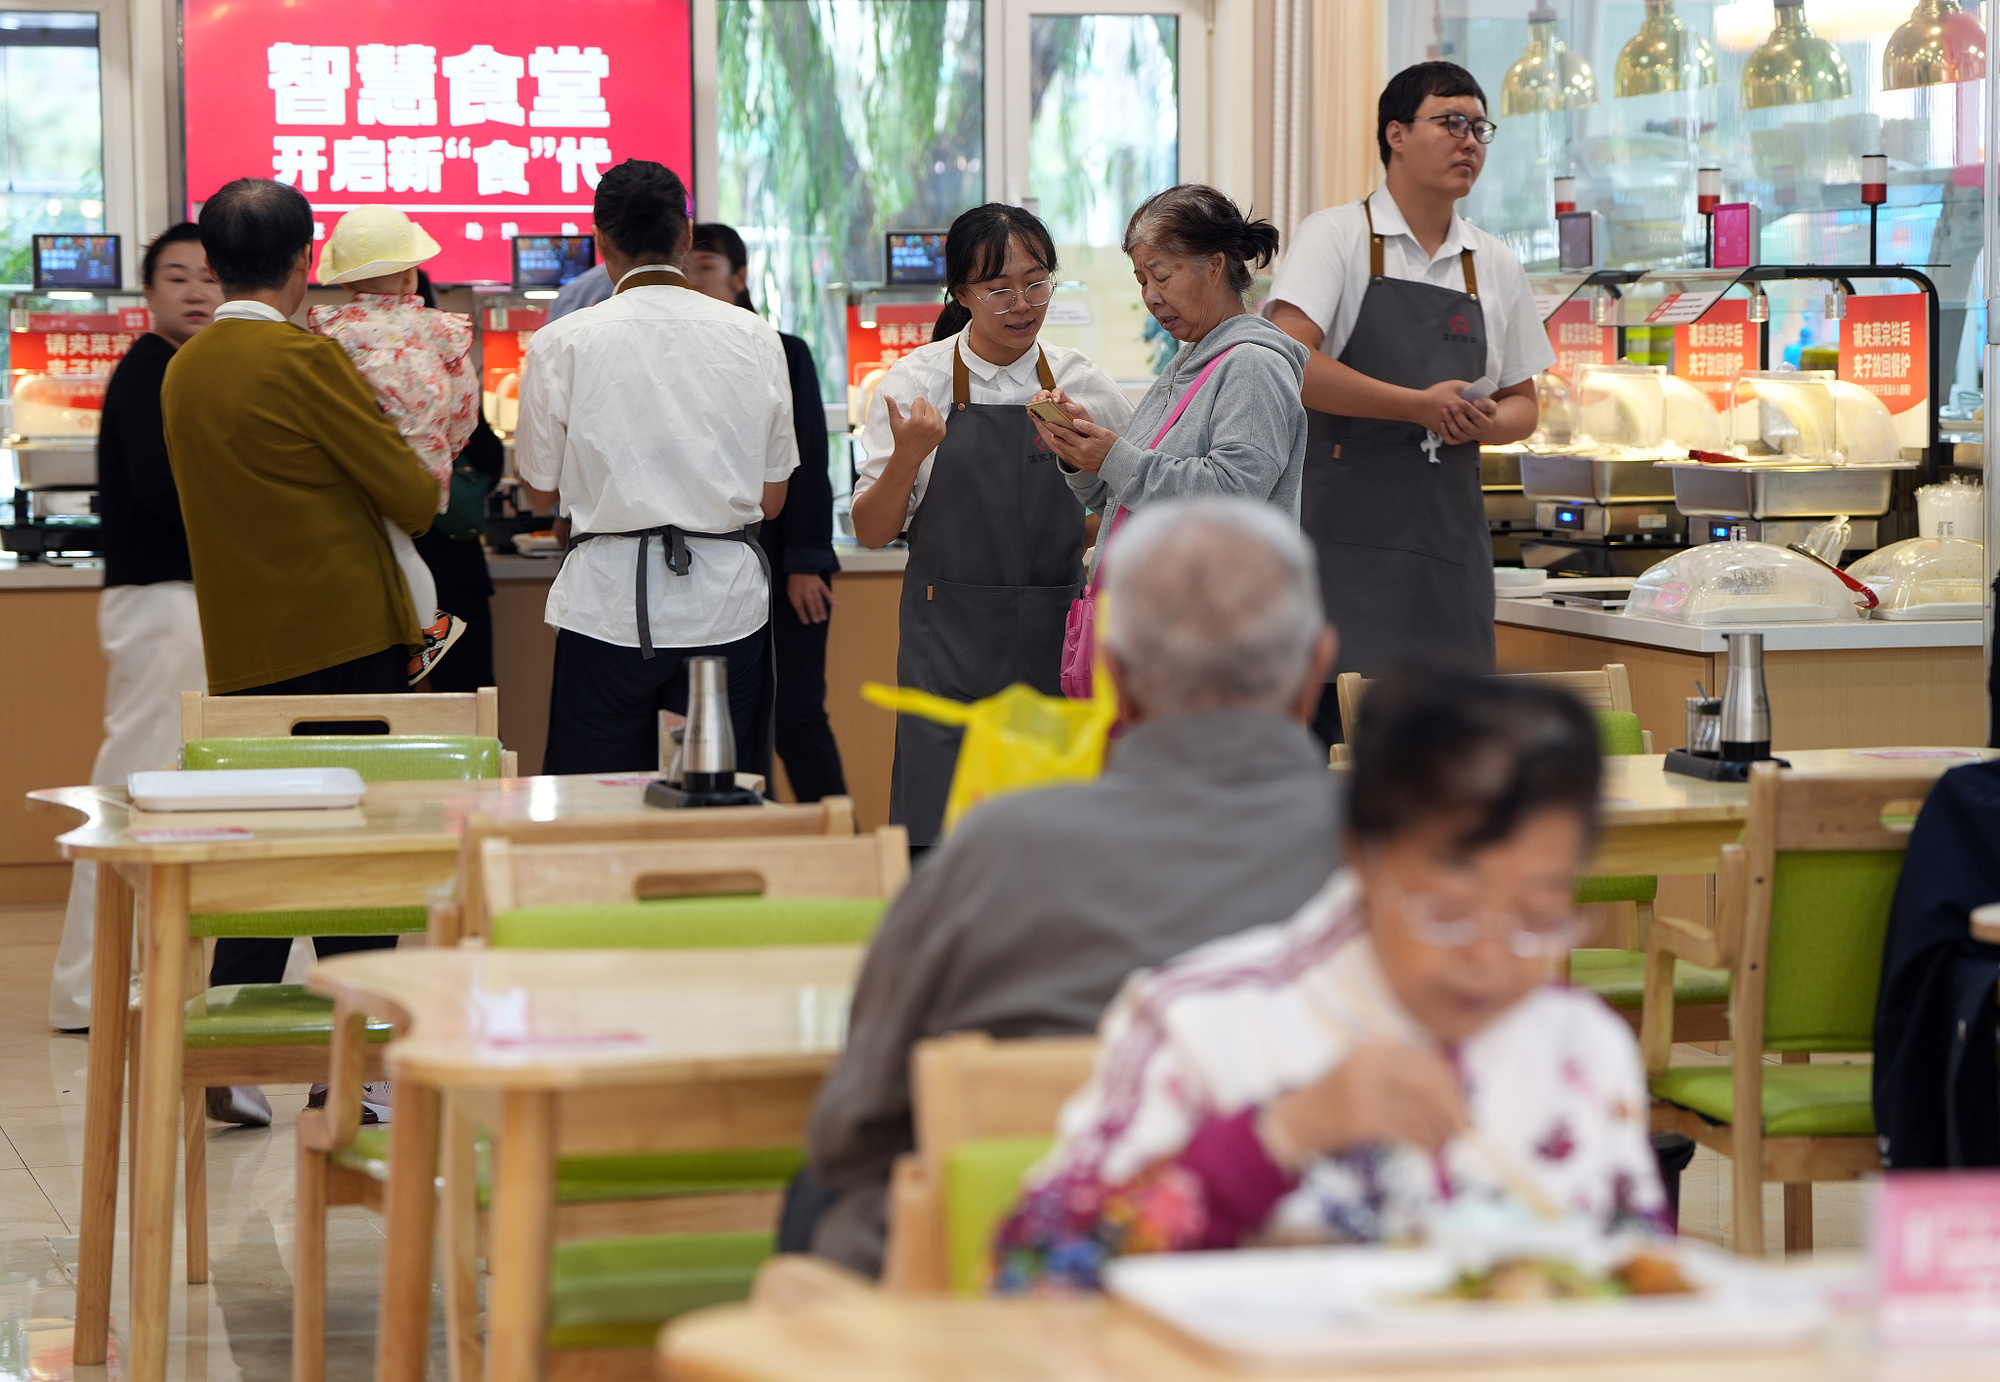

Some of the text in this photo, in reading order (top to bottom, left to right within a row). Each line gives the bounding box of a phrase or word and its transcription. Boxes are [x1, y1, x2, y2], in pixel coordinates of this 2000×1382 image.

[267, 42, 611, 127] 智慧食堂
[272, 136, 612, 195] 开启新“食”代
[45, 333, 140, 356] 请夹菜完
[1853, 321, 1911, 347] 请夹菜完毕后
[1853, 352, 1911, 378] 夹子放回餐炉
